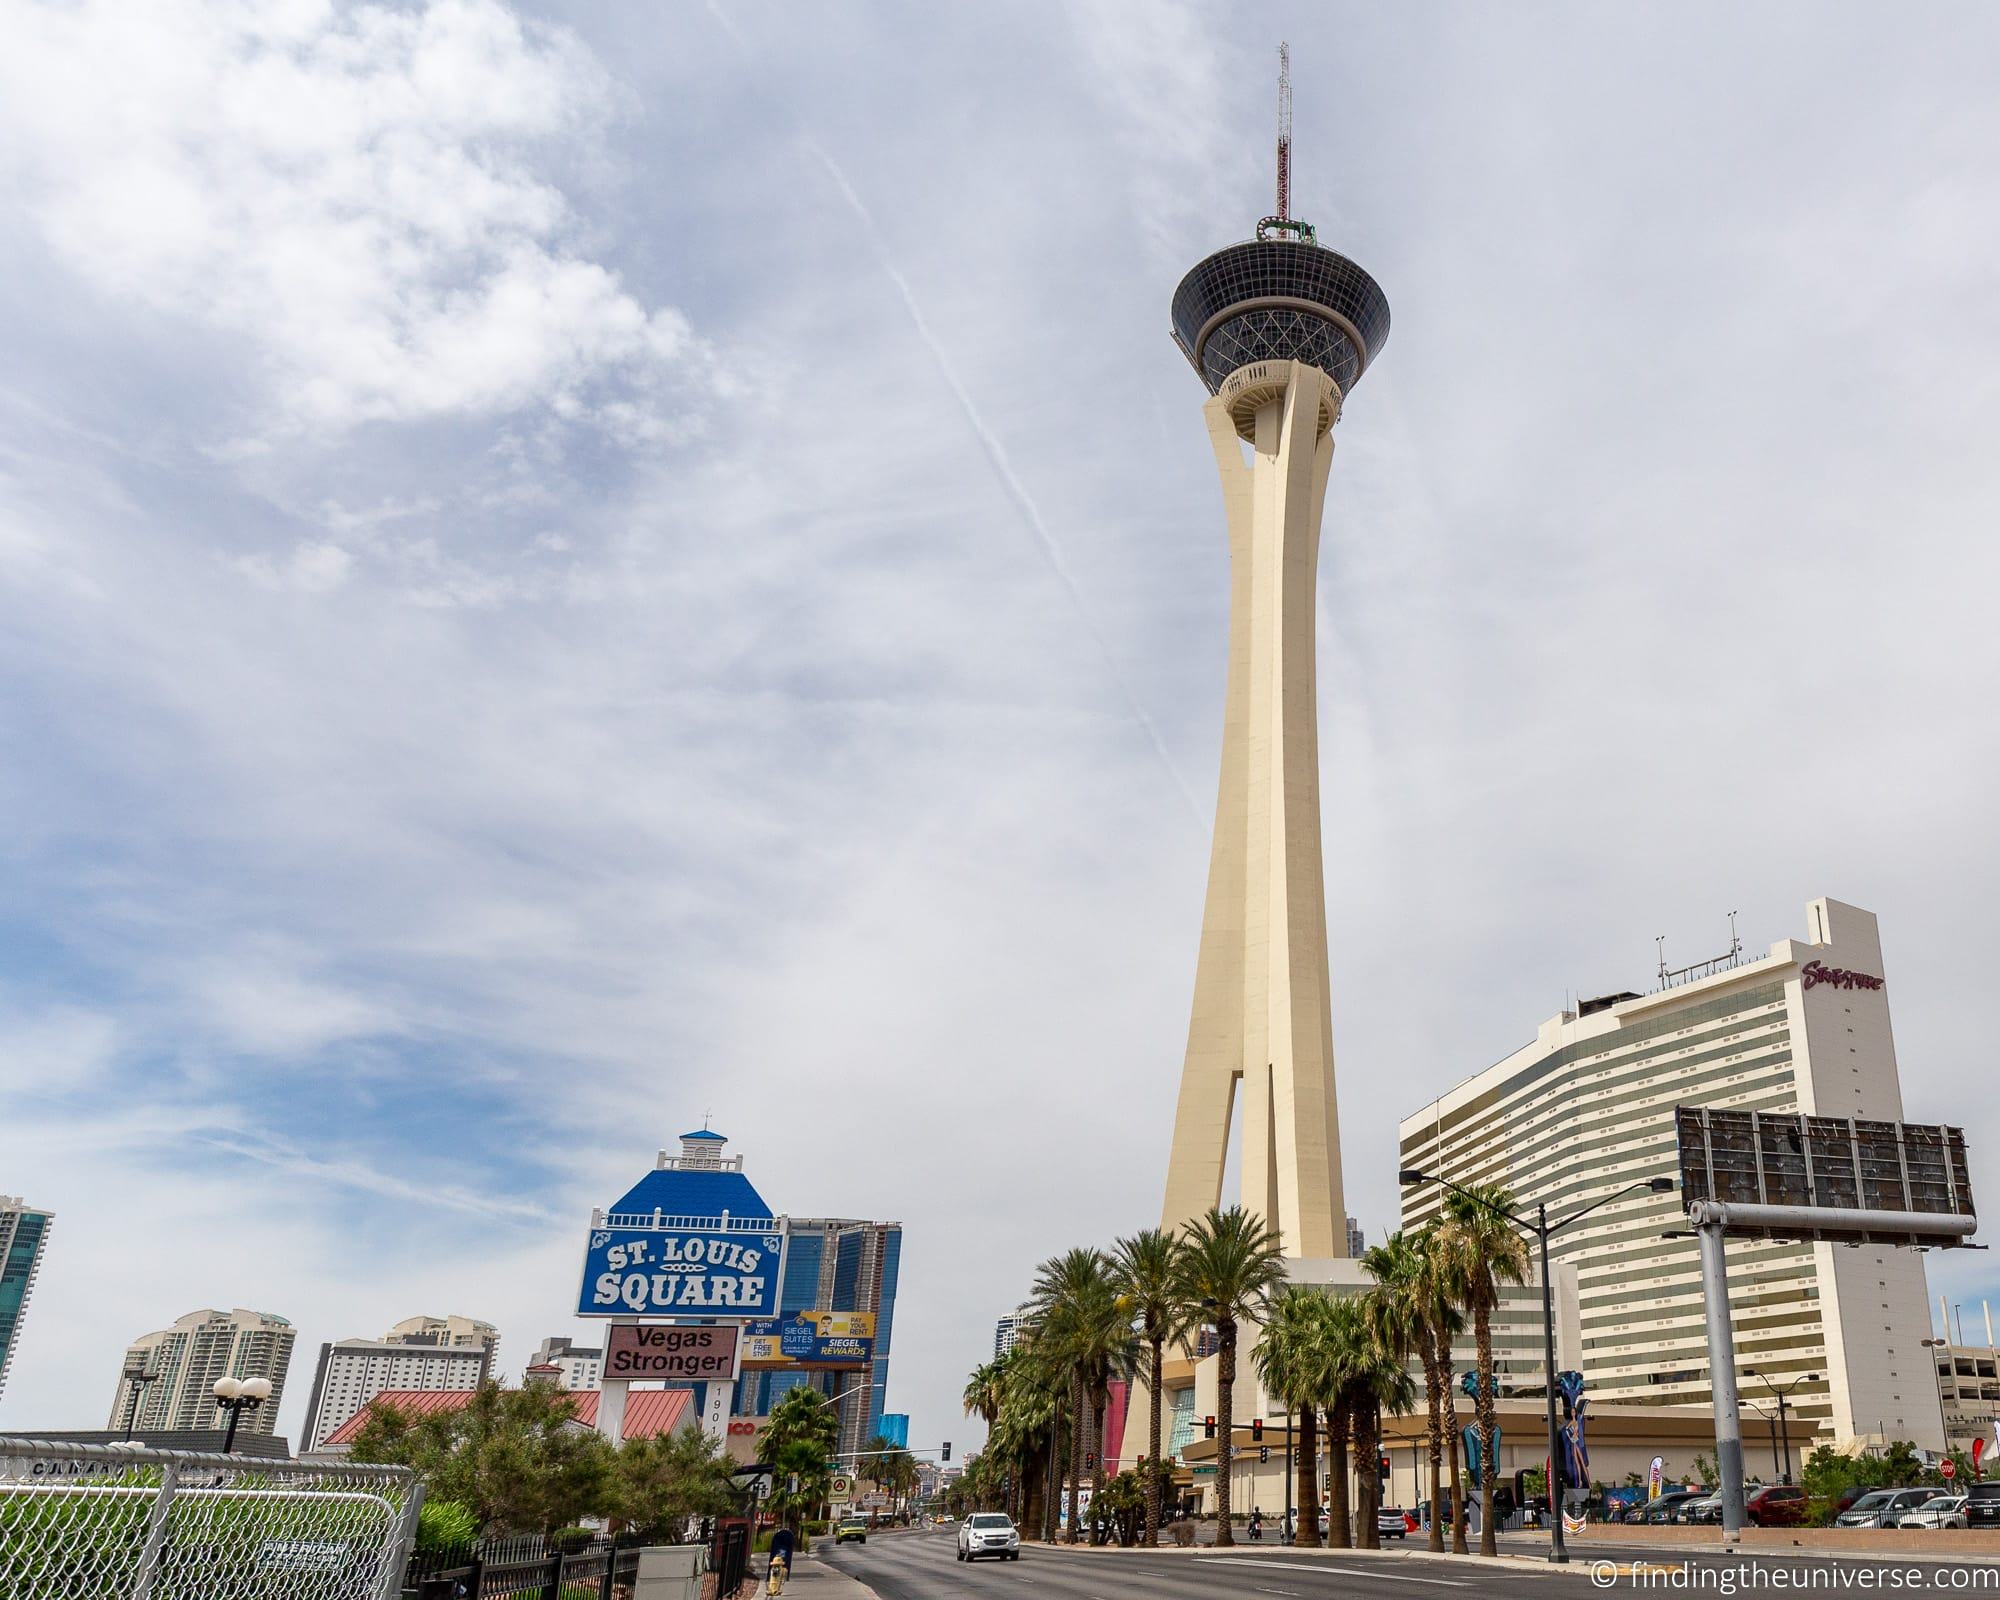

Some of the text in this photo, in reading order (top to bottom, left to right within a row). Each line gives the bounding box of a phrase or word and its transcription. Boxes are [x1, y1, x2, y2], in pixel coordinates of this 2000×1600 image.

[607, 1238, 761, 1273] ST. LOUIS
[593, 1273, 765, 1311] SQUARE
[783, 1335, 813, 1344] SUITES
[784, 1327, 813, 1335] SIEGEL
[636, 1328, 713, 1352] Vegas
[828, 1338, 860, 1347] SIEGEL
[821, 1346, 866, 1356] REWARDS
[613, 1350, 728, 1375] Stronger
[711, 1387, 721, 1434] 1901
[1941, 1465, 1954, 1473] STOP
